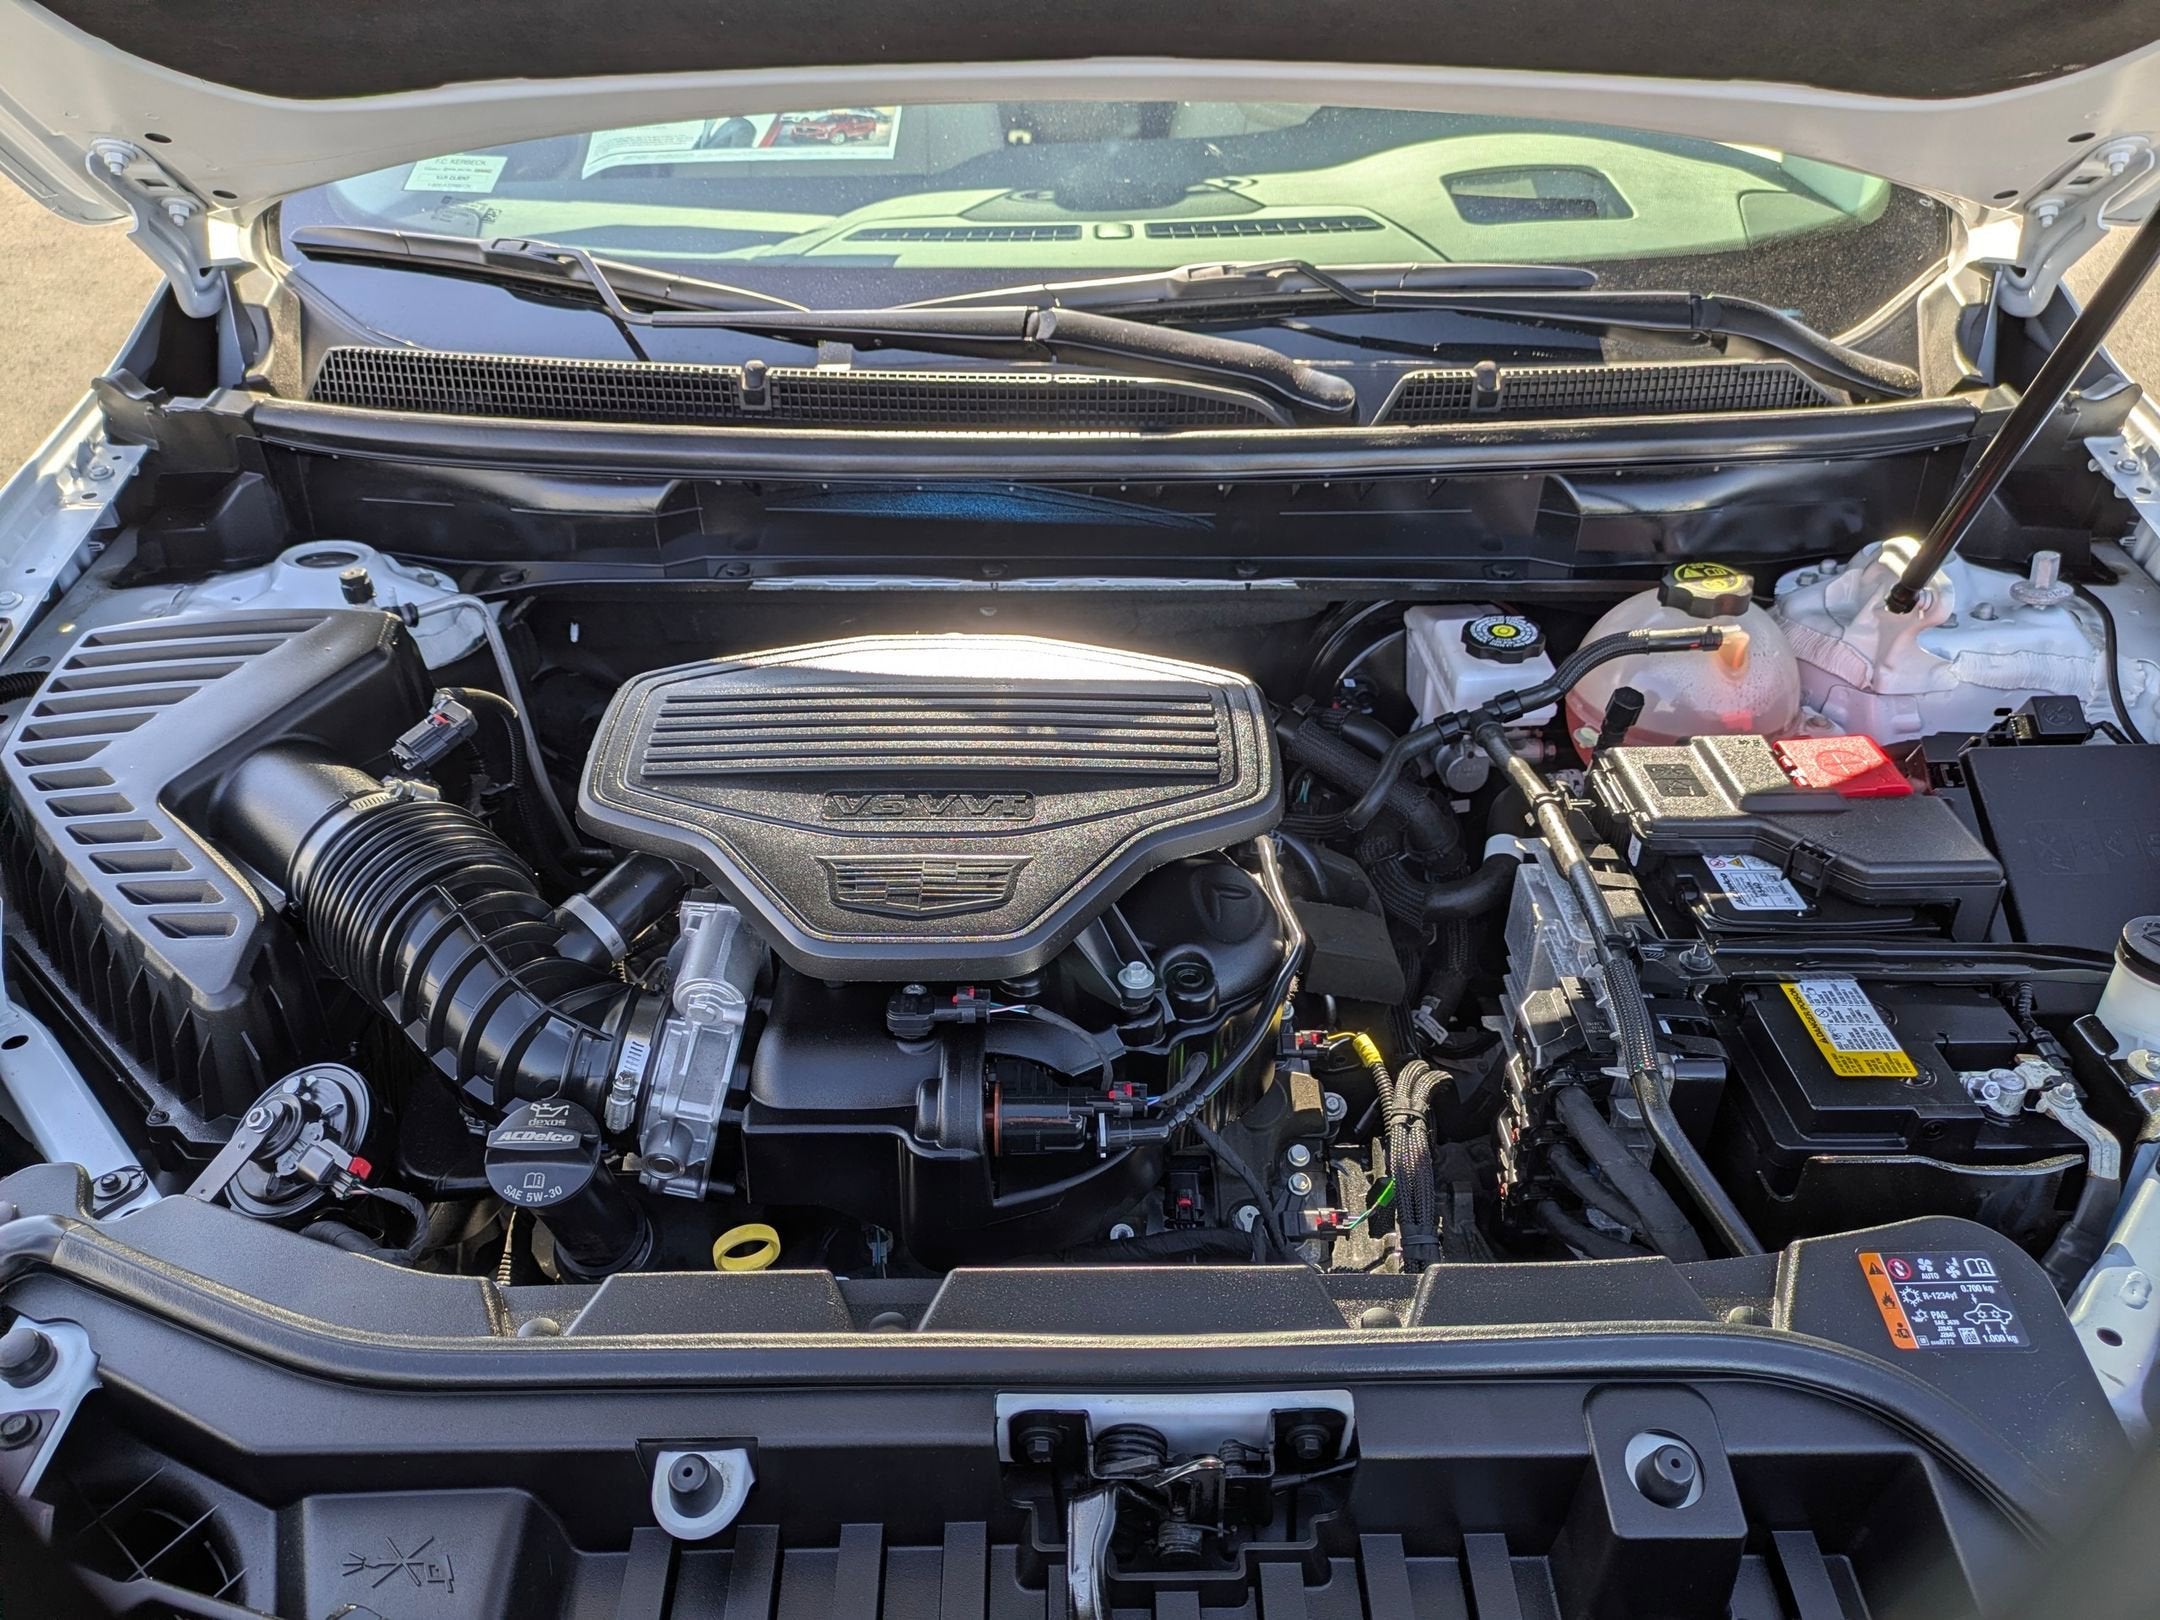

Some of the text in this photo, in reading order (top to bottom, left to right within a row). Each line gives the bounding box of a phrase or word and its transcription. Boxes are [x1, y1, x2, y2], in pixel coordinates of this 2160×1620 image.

[832, 794, 1027, 815] V6 VVT
[528, 1118, 567, 1126] dexos
[496, 1131, 575, 1142] ACDelco
[503, 1184, 563, 1202] SAE 5W-30
[1921, 1272, 1940, 1280] AUTO
[1960, 1284, 1995, 1294] 0.700 kg
[1921, 1291, 1959, 1301] R-1234yf
[1930, 1310, 1949, 1320] PAG
[1982, 1334, 2019, 1345] 1.000 kg
